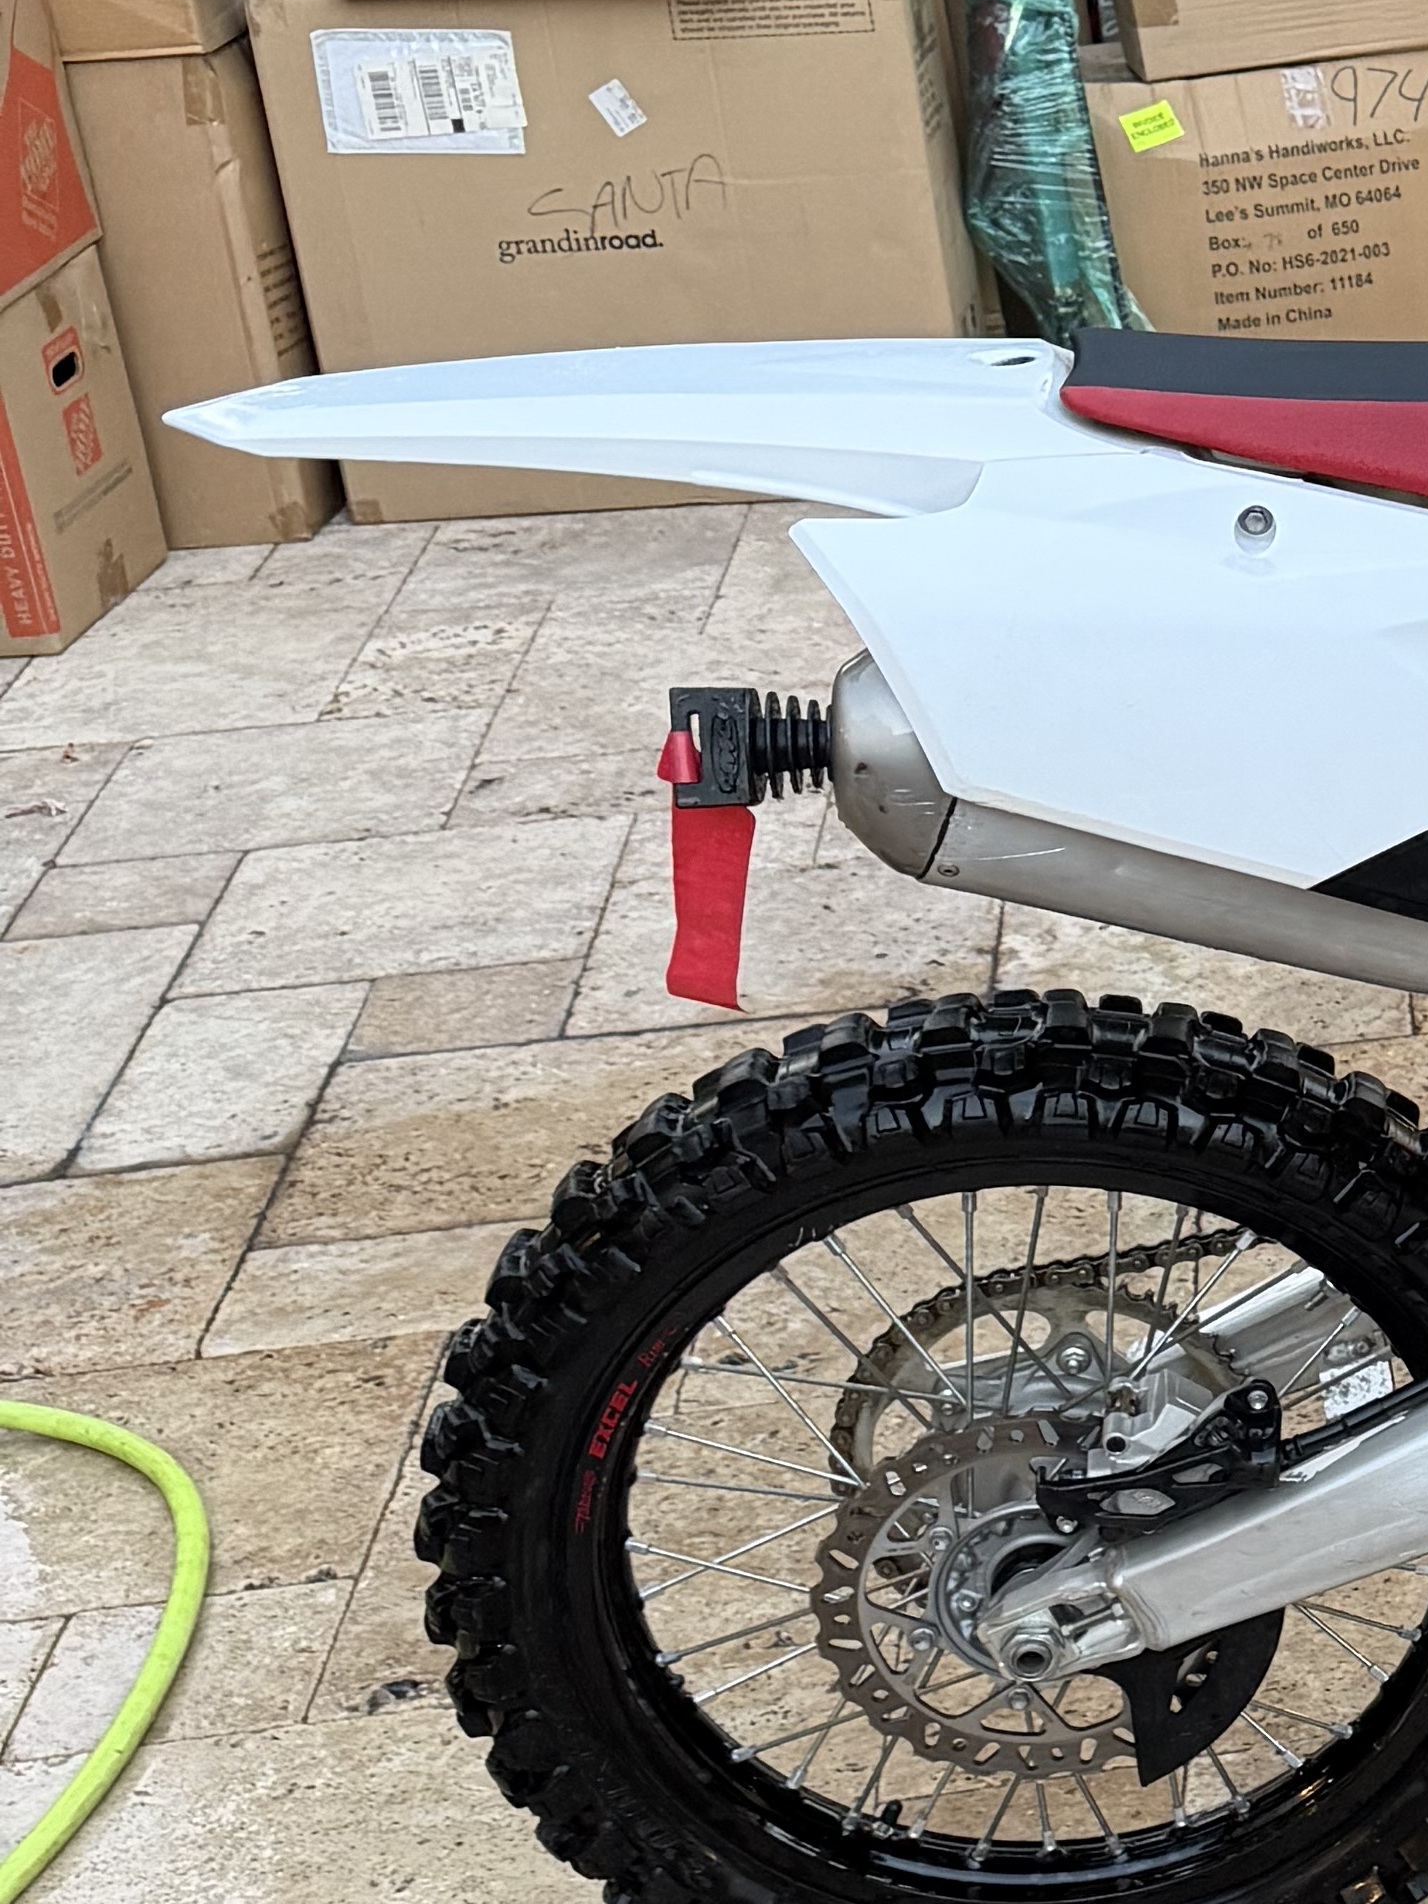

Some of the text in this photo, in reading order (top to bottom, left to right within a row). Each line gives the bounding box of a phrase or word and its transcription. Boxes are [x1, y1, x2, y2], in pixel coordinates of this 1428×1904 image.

[1199, 128, 1411, 169] Hanna's Handiworks, LLC.
[527, 153, 728, 234] SANTA
[1202, 156, 1420, 196] 350 NW Space Center Drive
[1205, 185, 1402, 225] Lee's Summit, MO 64064
[498, 227, 664, 264] grandinroad.
[1307, 223, 1324, 240] of
[1331, 219, 1360, 238] 650
[1211, 243, 1391, 279] P.O. No: HS6-2021-003
[1213, 273, 1374, 306] Item Number: 11184
[1217, 306, 1333, 333] Made in China
[7, 567, 32, 625] HEAVY
[588, 1379, 638, 1460] EXCEL
